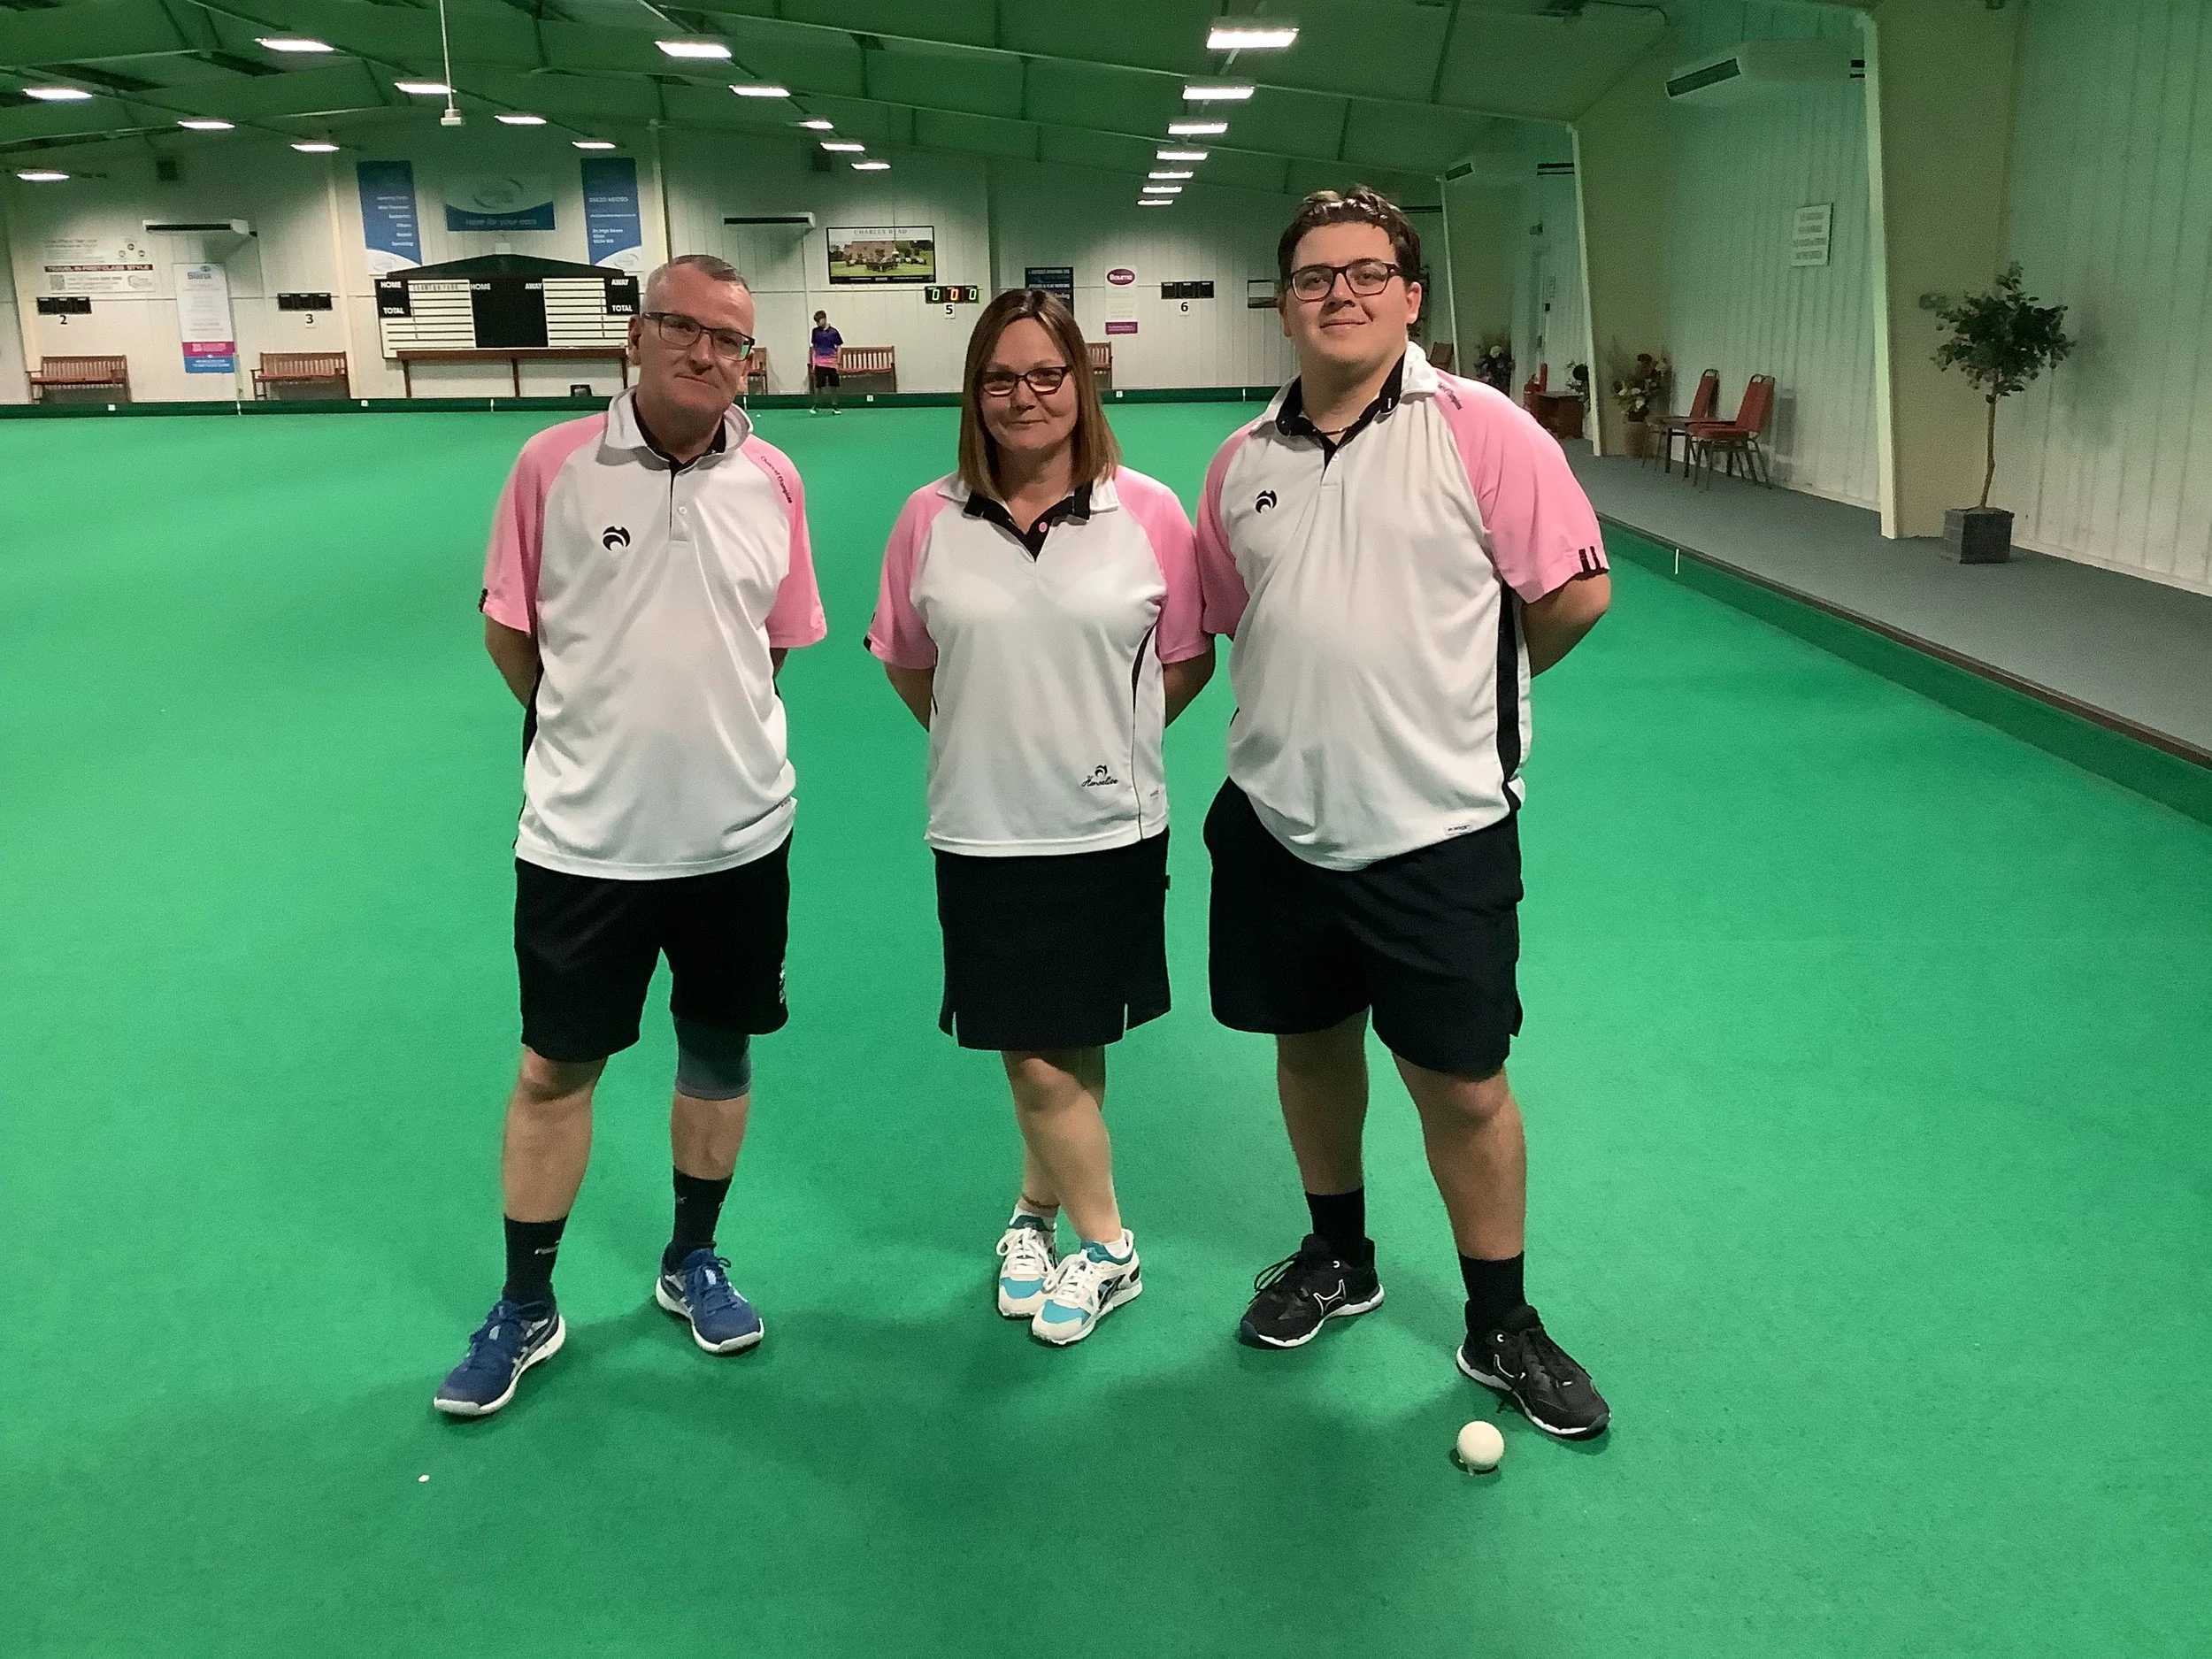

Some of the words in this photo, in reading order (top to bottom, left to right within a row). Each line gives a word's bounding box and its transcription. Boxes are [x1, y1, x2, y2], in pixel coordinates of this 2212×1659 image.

[932, 289, 941, 301] 0
[950, 288, 959, 301] 0
[969, 288, 977, 301] 0
[945, 304, 954, 315] 5
[1180, 302, 1189, 312] 6
[59, 314, 68, 325] 2
[305, 313, 314, 324] 3
